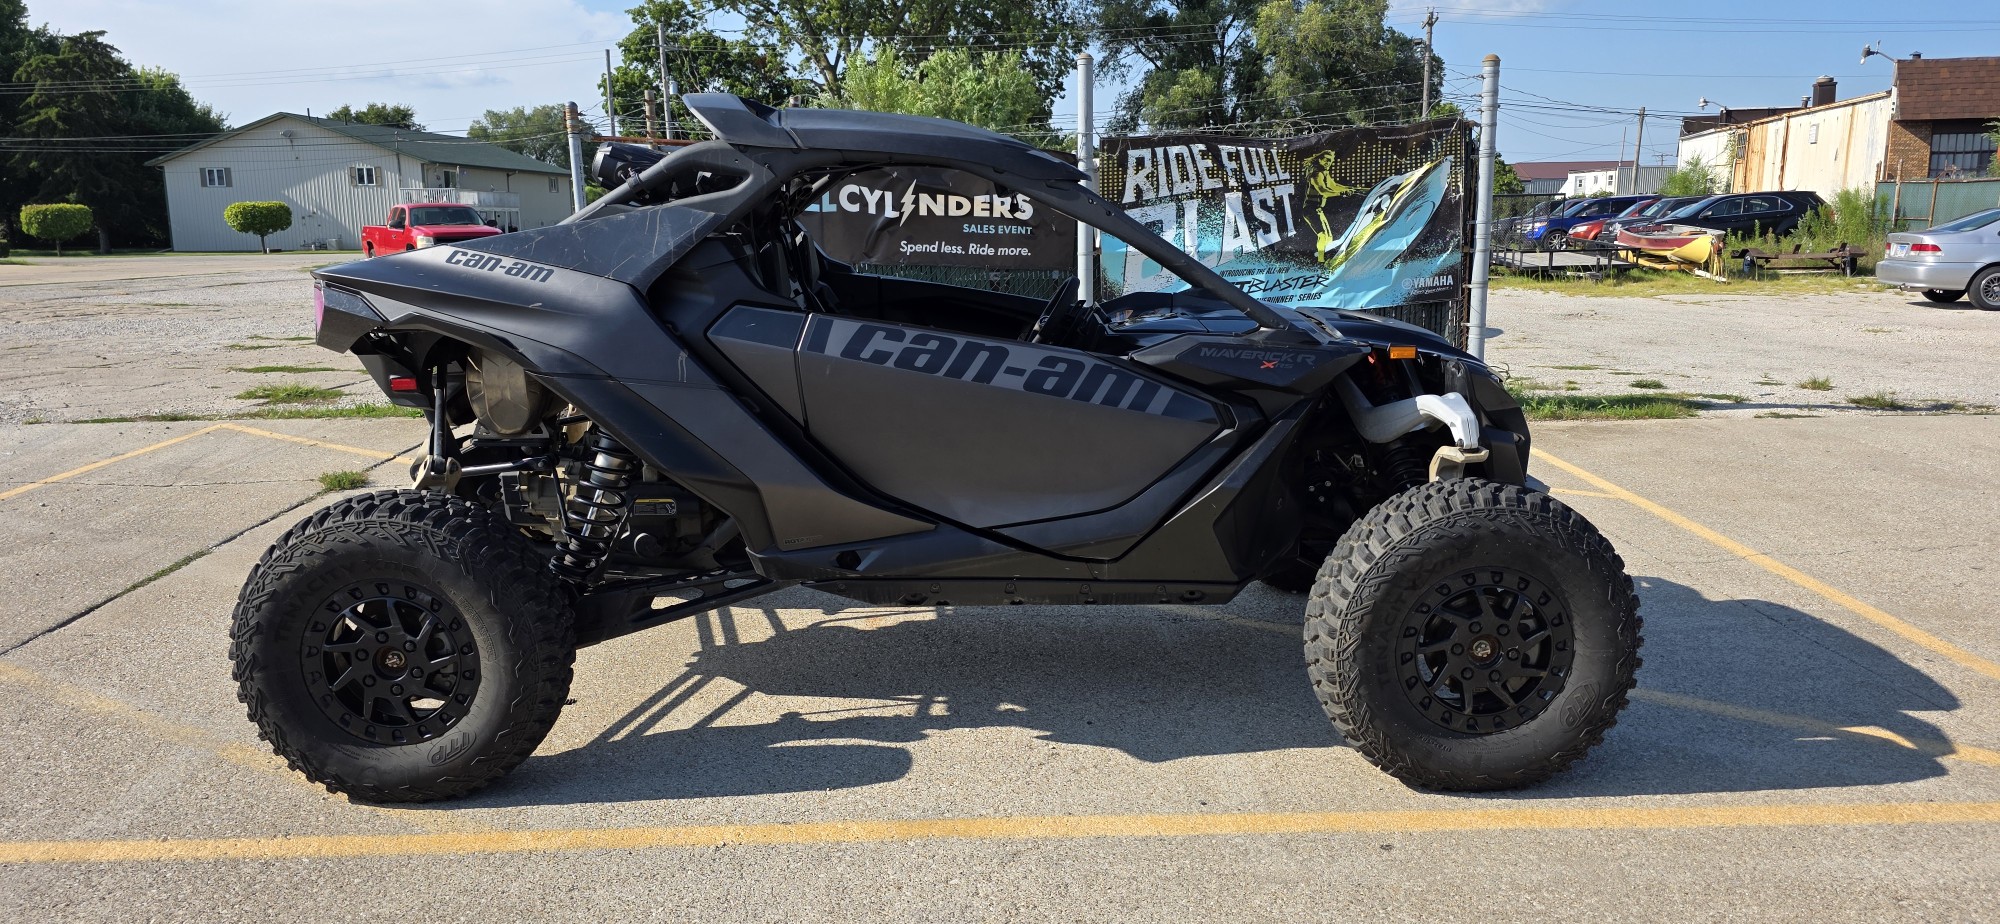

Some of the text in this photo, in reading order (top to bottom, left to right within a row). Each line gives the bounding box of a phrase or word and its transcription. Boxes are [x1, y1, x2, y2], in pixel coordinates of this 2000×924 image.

[1122, 144, 1290, 204] RIDE FULL
[963, 223, 1032, 235] SALES EVENT
[900, 240, 1031, 256] Spend less. Ride more.
[445, 249, 555, 283] can-am
[1220, 268, 1255, 278] INTRODUCING
[1266, 266, 1291, 275] ALL-NEW
[1413, 275, 1453, 288] YAMAHA
[1297, 291, 1322, 302] SERIES
[1200, 347, 1294, 363] MAVERICK
[839, 323, 1162, 417] can-am
[431, 732, 470, 766] ITP
